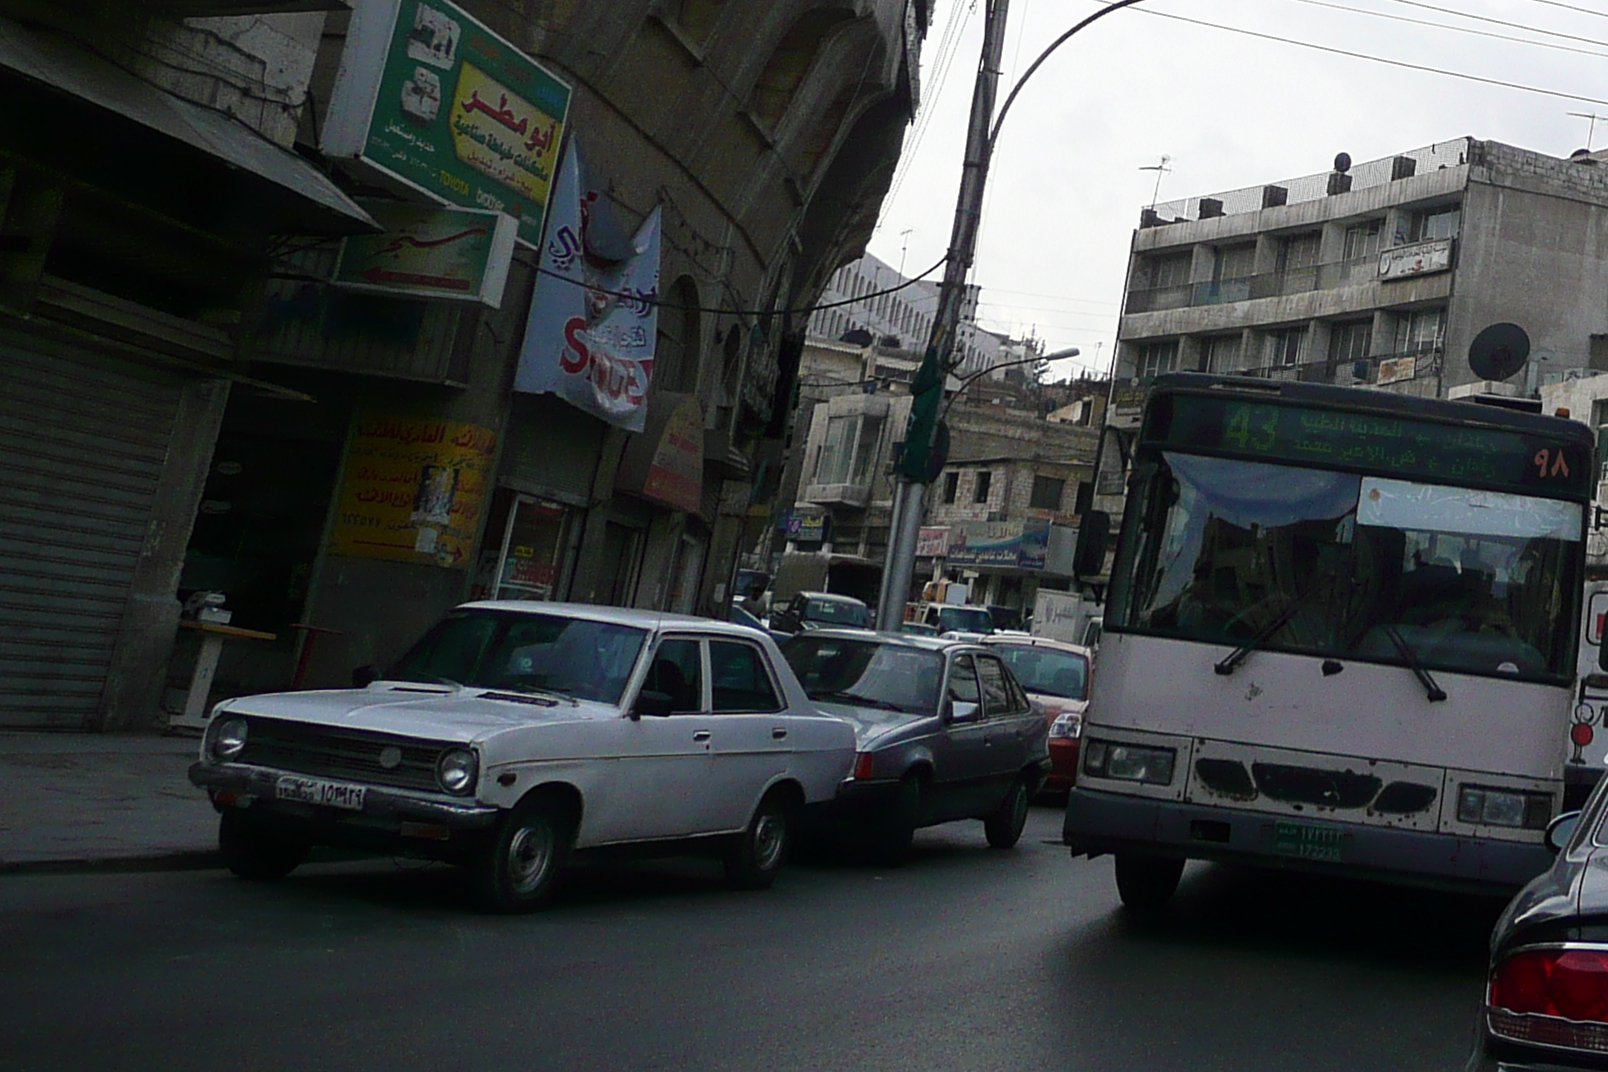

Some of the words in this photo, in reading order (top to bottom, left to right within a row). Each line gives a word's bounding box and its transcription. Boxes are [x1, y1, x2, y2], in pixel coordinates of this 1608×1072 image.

[461, 88, 529, 136] مطر
[524, 120, 557, 159] أبو
[440, 169, 471, 197] TOYOTA
[1224, 404, 1280, 452] 43
[1533, 448, 1570, 477] ٩٨
